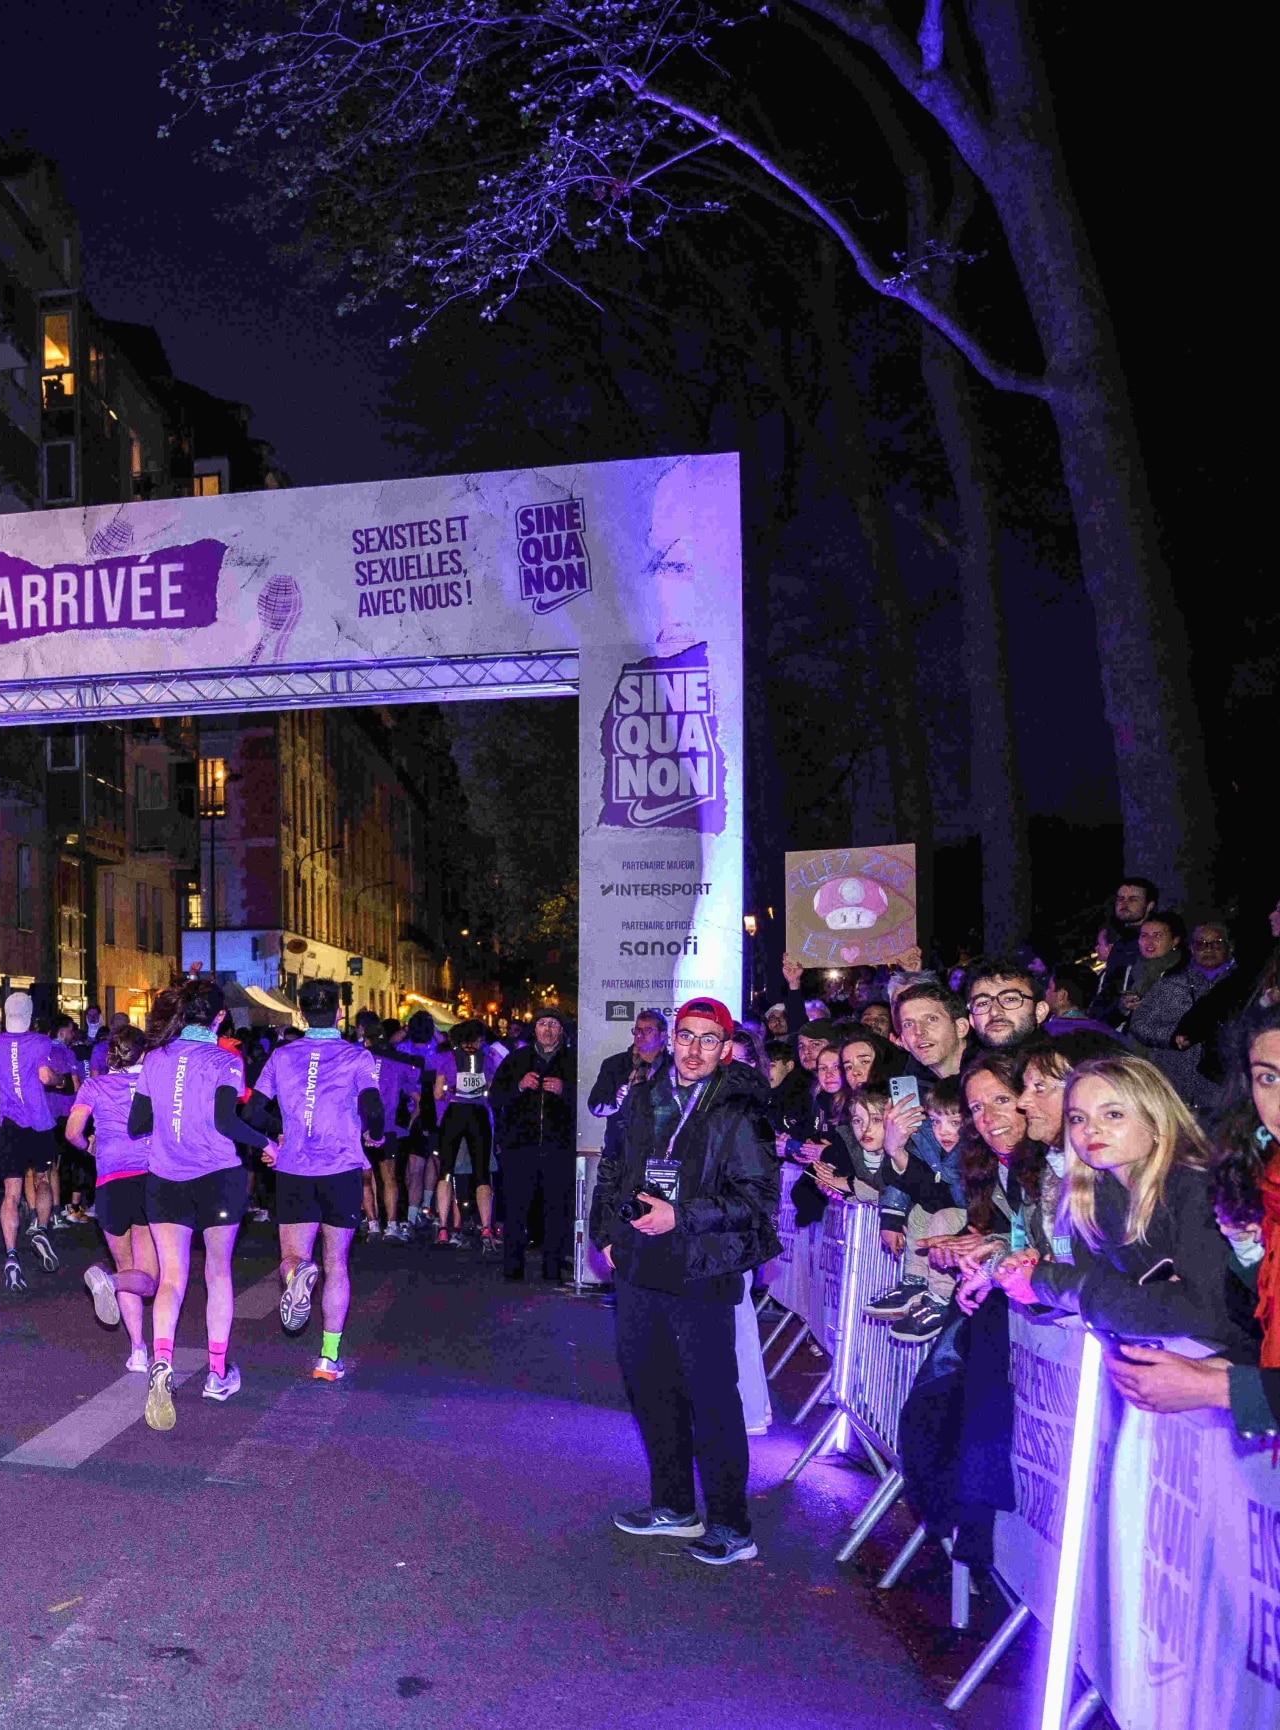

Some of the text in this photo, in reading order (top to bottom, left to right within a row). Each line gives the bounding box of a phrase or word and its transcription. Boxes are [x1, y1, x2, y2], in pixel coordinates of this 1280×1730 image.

[352, 515, 469, 555] SEXISTES ET
[520, 502, 581, 536] SINE
[522, 531, 584, 565] QUA
[354, 549, 468, 586] SEXUELLES,
[524, 562, 587, 596] NON
[358, 588, 406, 618] AVEC
[410, 581, 462, 611] NOUS
[619, 672, 708, 715] SINE
[619, 712, 709, 758] QUA
[618, 756, 709, 798] NON
[622, 860, 695, 870] PARTENAIRE MAJEUR
[787, 852, 850, 896] ALLEZ
[616, 883, 712, 897] INTERSPORT
[621, 920, 696, 930] PARTENAIRE OFFICIEL
[619, 936, 698, 956] sanofi
[802, 931, 845, 961] ET
[601, 979, 650, 989] PARTENAIRES
[10, 1048, 21, 1091] EQUALITY
[305, 1061, 318, 1109] EQUALITY
[463, 1077, 480, 1087] 5185
[172, 1065, 186, 1117] EQUALITY
[1151, 1414, 1200, 1503] SINE
[1148, 1484, 1193, 1580] QUA
[1143, 1561, 1189, 1662] NON
